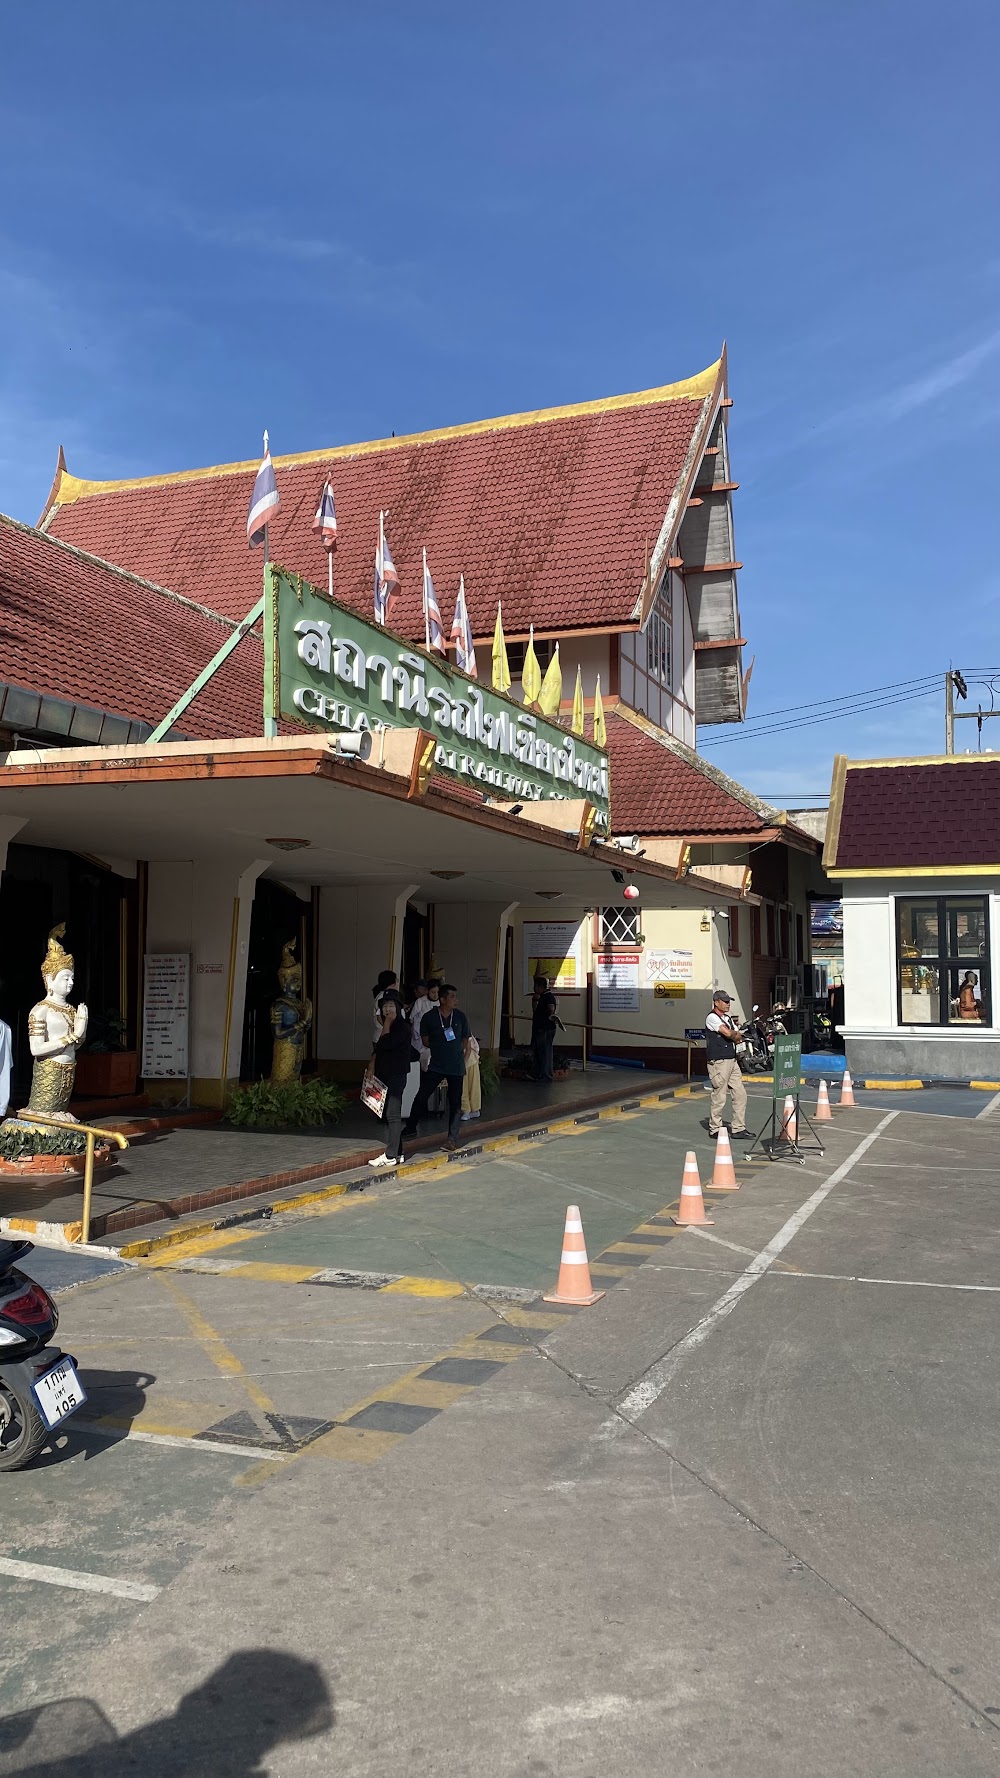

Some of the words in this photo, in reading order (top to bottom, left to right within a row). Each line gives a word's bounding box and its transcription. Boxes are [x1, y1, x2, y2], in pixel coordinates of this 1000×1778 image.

[294, 620, 608, 799] สถานีรถไฟเชียงใหม่
[434, 745, 458, 772] AI
[459, 753, 544, 801] RAILWAY
[55, 1393, 77, 1417] 105
